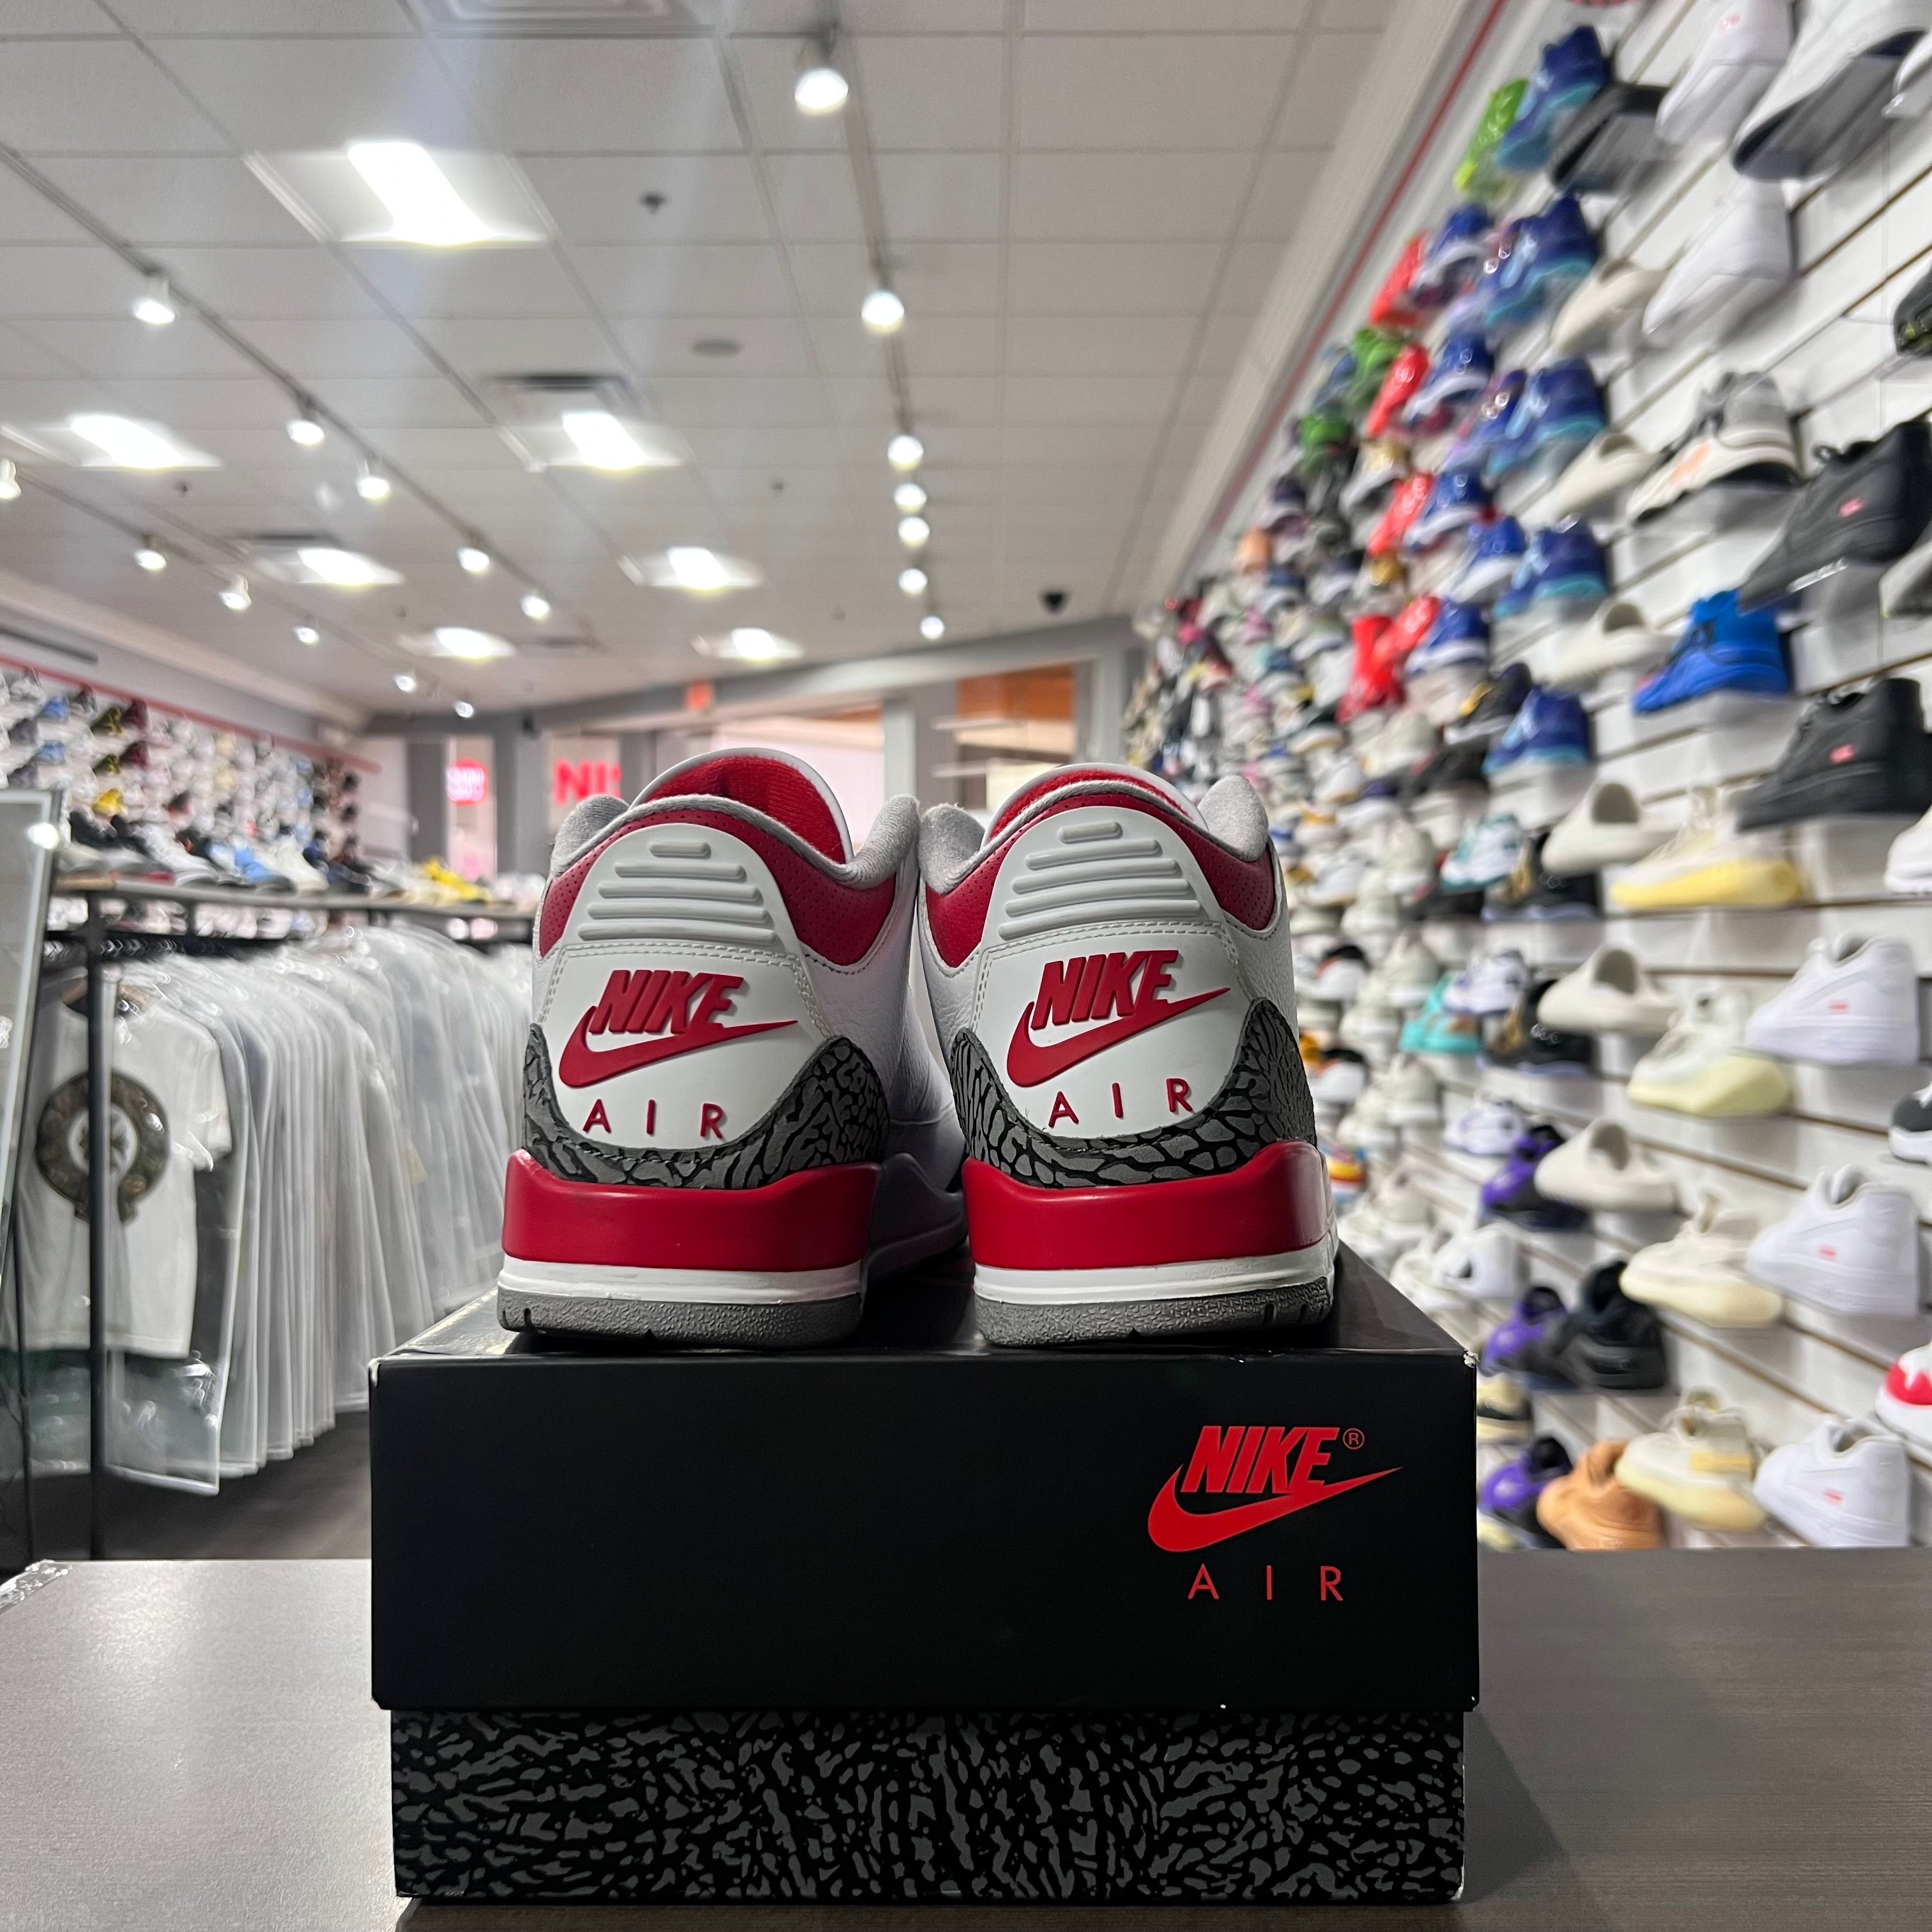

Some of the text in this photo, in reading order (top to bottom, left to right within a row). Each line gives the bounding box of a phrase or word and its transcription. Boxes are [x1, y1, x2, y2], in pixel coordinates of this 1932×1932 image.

[588, 970, 744, 1035] NIKE
[1031, 950, 1179, 1030] NIKE
[582, 1098, 726, 1139] AIR
[1048, 1077, 1193, 1128] AIR
[1188, 1563, 1343, 1602] AIR
